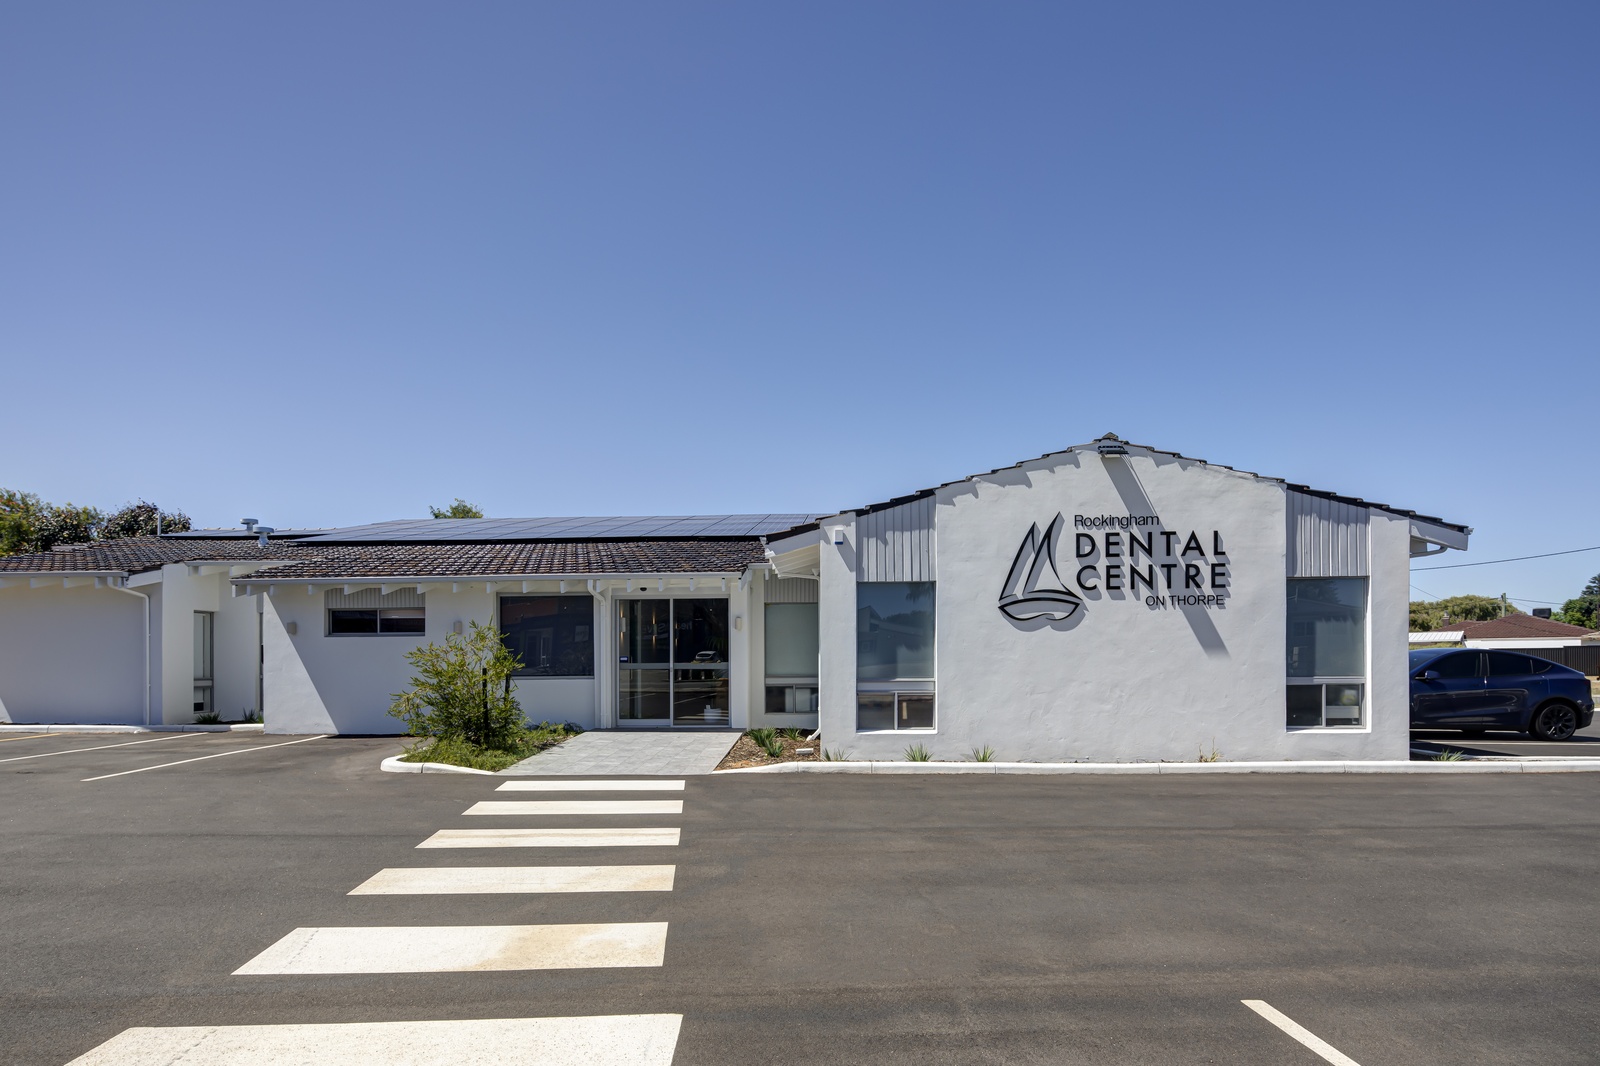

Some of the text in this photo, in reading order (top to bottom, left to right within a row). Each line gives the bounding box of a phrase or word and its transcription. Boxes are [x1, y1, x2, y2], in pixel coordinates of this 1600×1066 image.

[1074, 514, 1160, 528] Rockingham
[1076, 531, 1226, 558] DENTAL
[1076, 563, 1226, 591] CENTRE
[1145, 595, 1225, 606] ON THORPE
